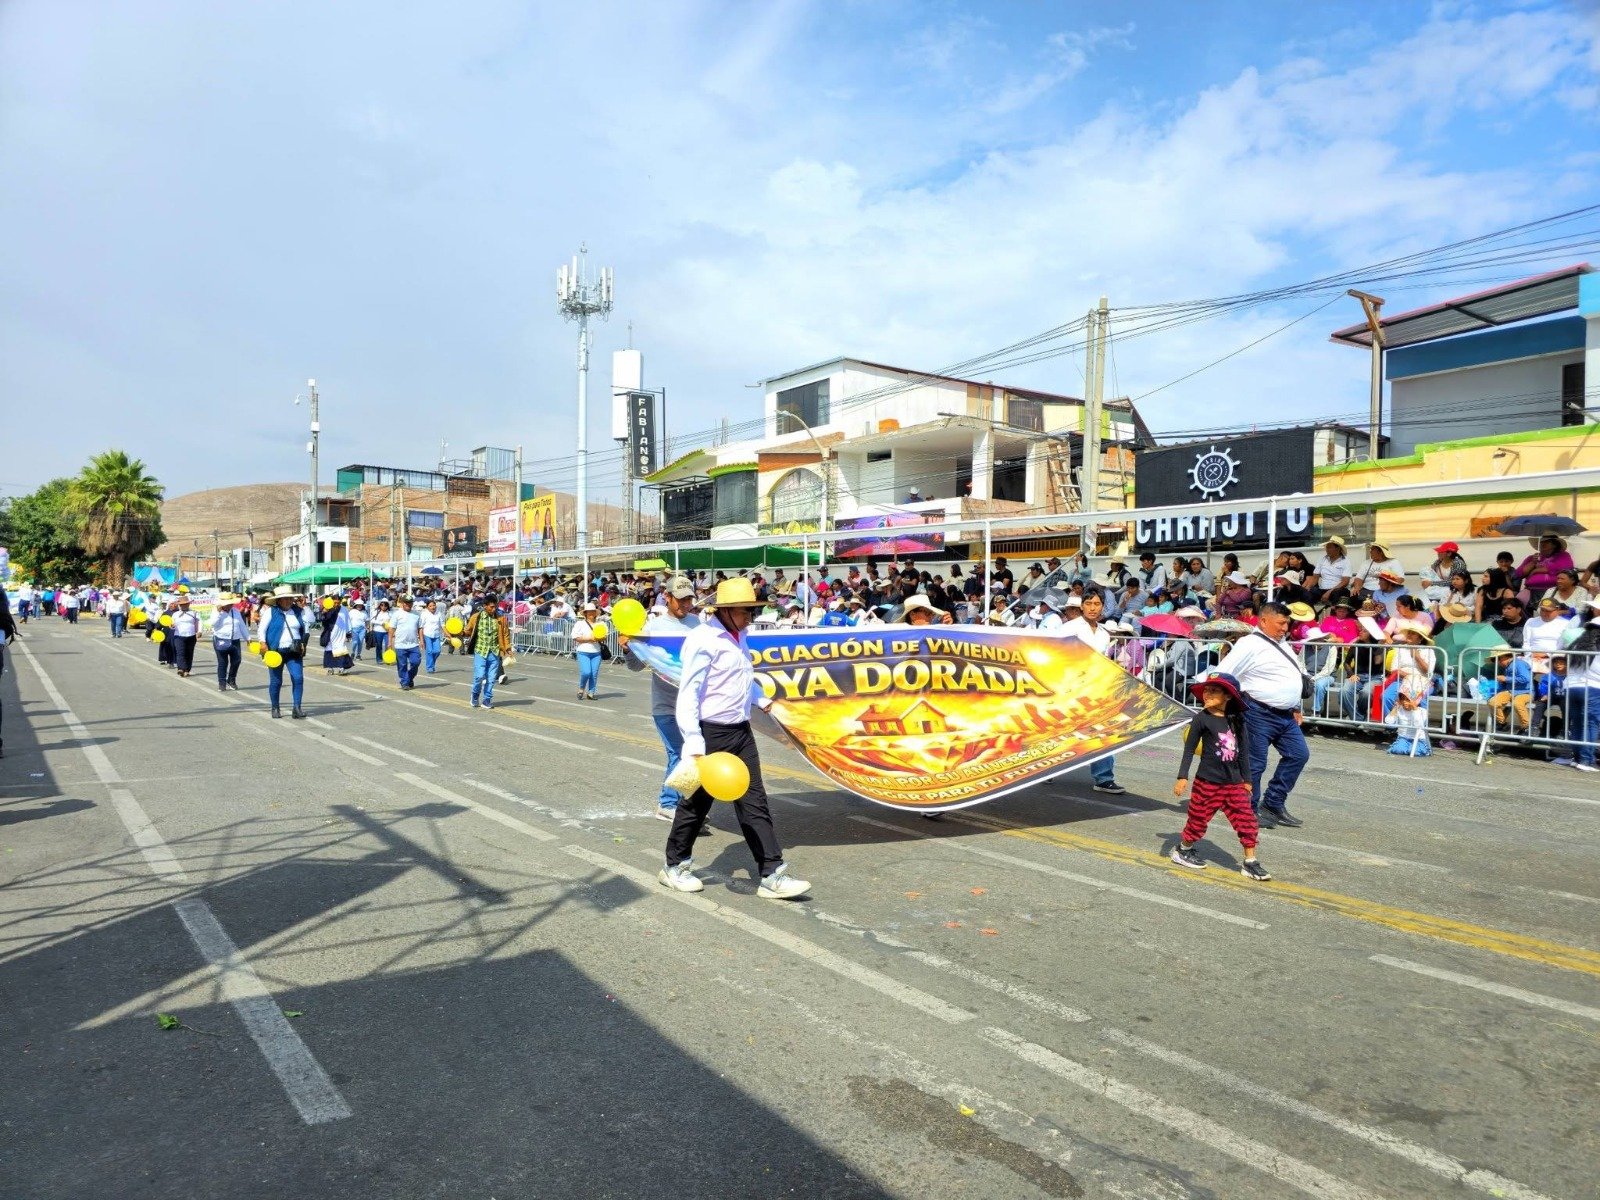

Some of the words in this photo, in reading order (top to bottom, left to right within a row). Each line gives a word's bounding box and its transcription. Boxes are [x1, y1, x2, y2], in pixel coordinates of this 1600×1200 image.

[638, 397, 650, 475] FABIANOS
[750, 637, 884, 666] OCIACIÓN
[892, 640, 921, 653] DE
[925, 637, 1026, 665] VIVIENDA
[753, 666, 845, 701] OYA
[851, 659, 1056, 697] DORADA
[895, 774, 933, 788] POR
[935, 770, 961, 783] SU
[925, 785, 976, 801] PARA
[976, 777, 1003, 788] TU
[1003, 751, 1077, 779] FUTURO
